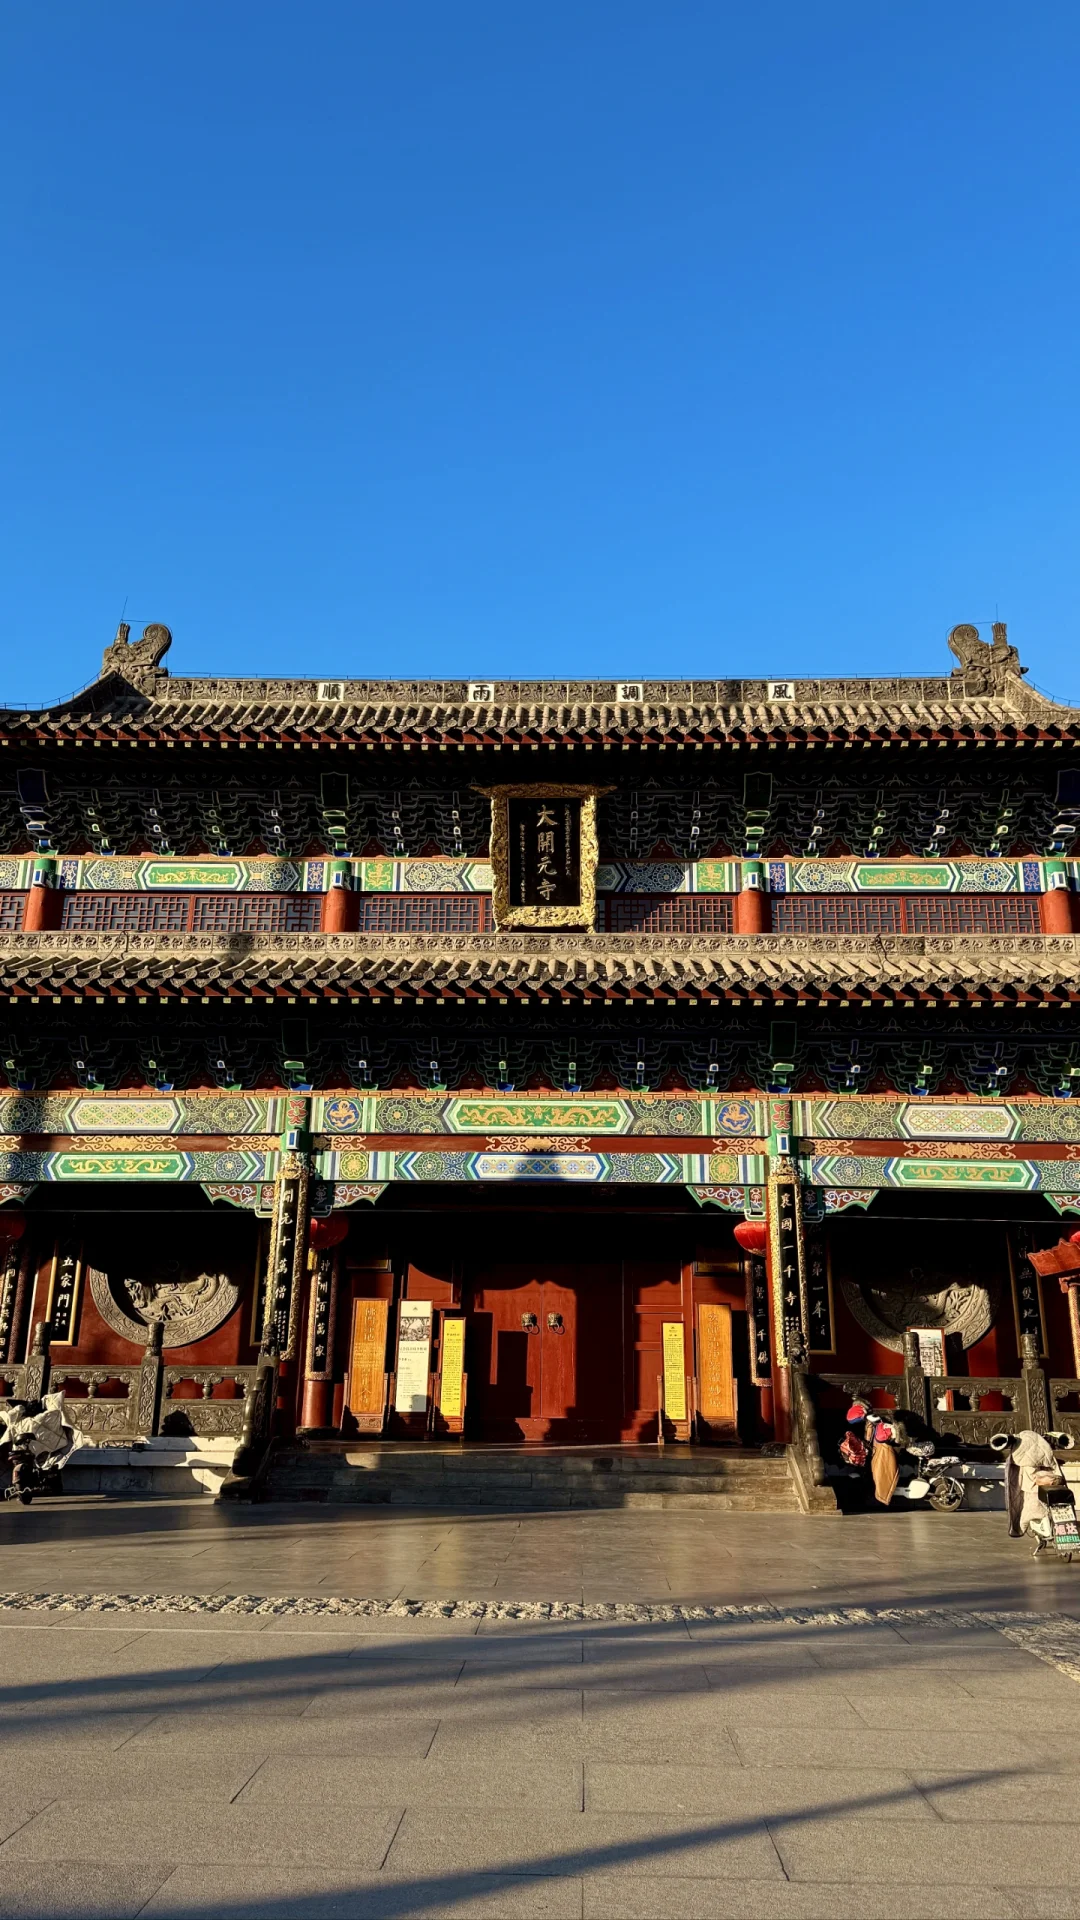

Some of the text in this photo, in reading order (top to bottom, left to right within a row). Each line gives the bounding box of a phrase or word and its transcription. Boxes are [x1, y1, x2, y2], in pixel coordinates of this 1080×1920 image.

[322, 683, 792, 701] 順 雨 調 風
[536, 804, 559, 901] 大開元寺
